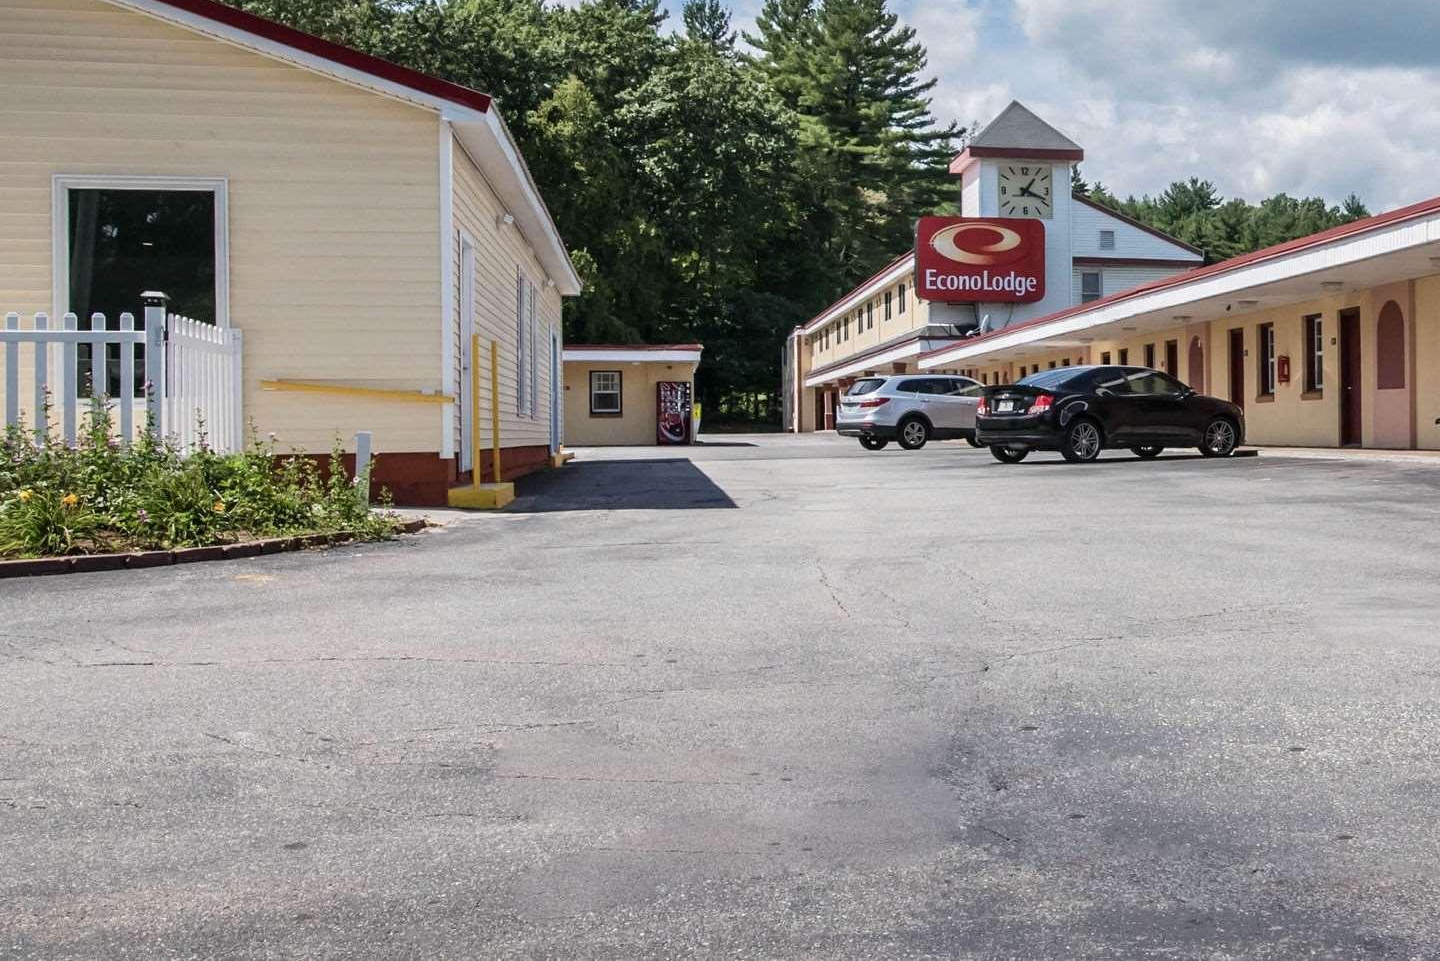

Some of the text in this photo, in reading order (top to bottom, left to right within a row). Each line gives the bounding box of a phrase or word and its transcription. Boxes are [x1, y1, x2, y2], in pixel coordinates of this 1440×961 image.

[1021, 166, 1029, 176] 12
[1023, 206, 1029, 215] 6
[925, 269, 1037, 296] EconoLodge
